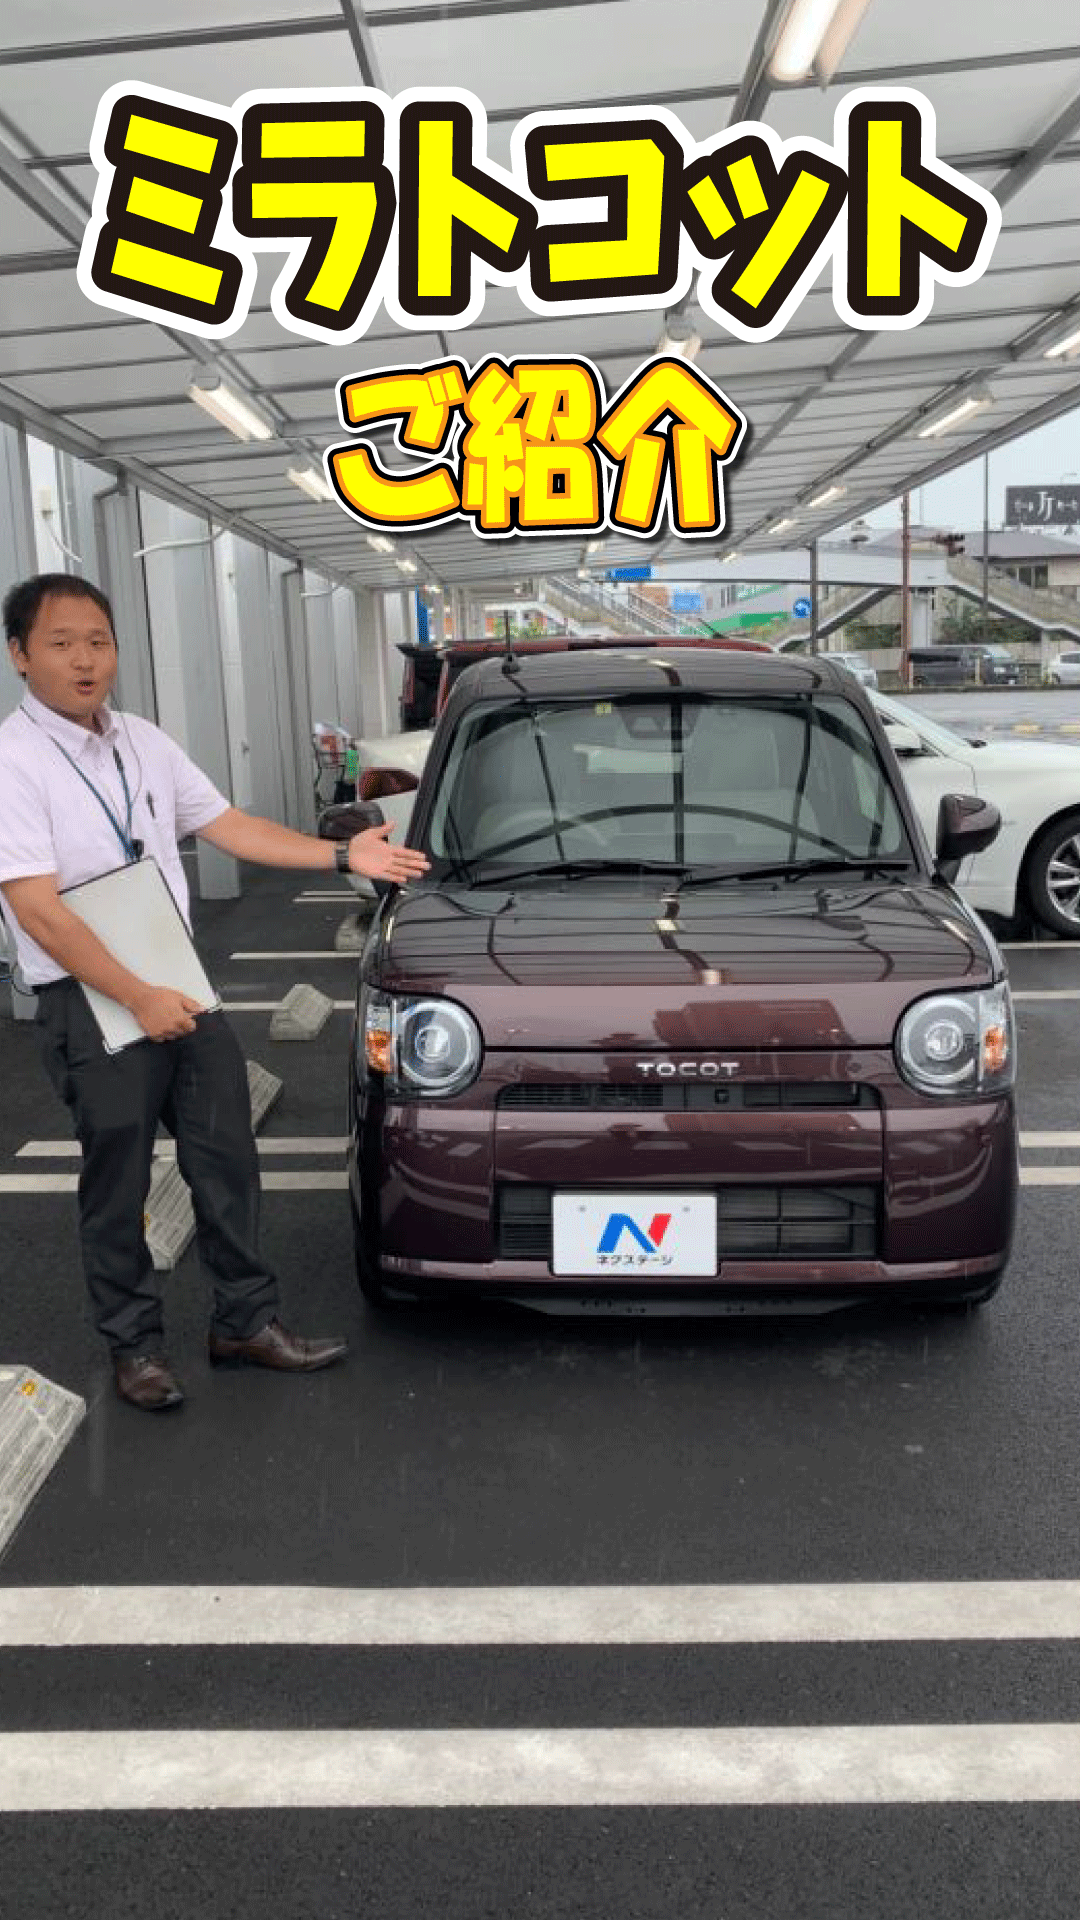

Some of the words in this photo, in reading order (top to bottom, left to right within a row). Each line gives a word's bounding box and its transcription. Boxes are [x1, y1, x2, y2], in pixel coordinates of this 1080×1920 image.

[636, 1062, 740, 1077] TOCOT
[597, 1254, 673, 1266] ネクステージ
